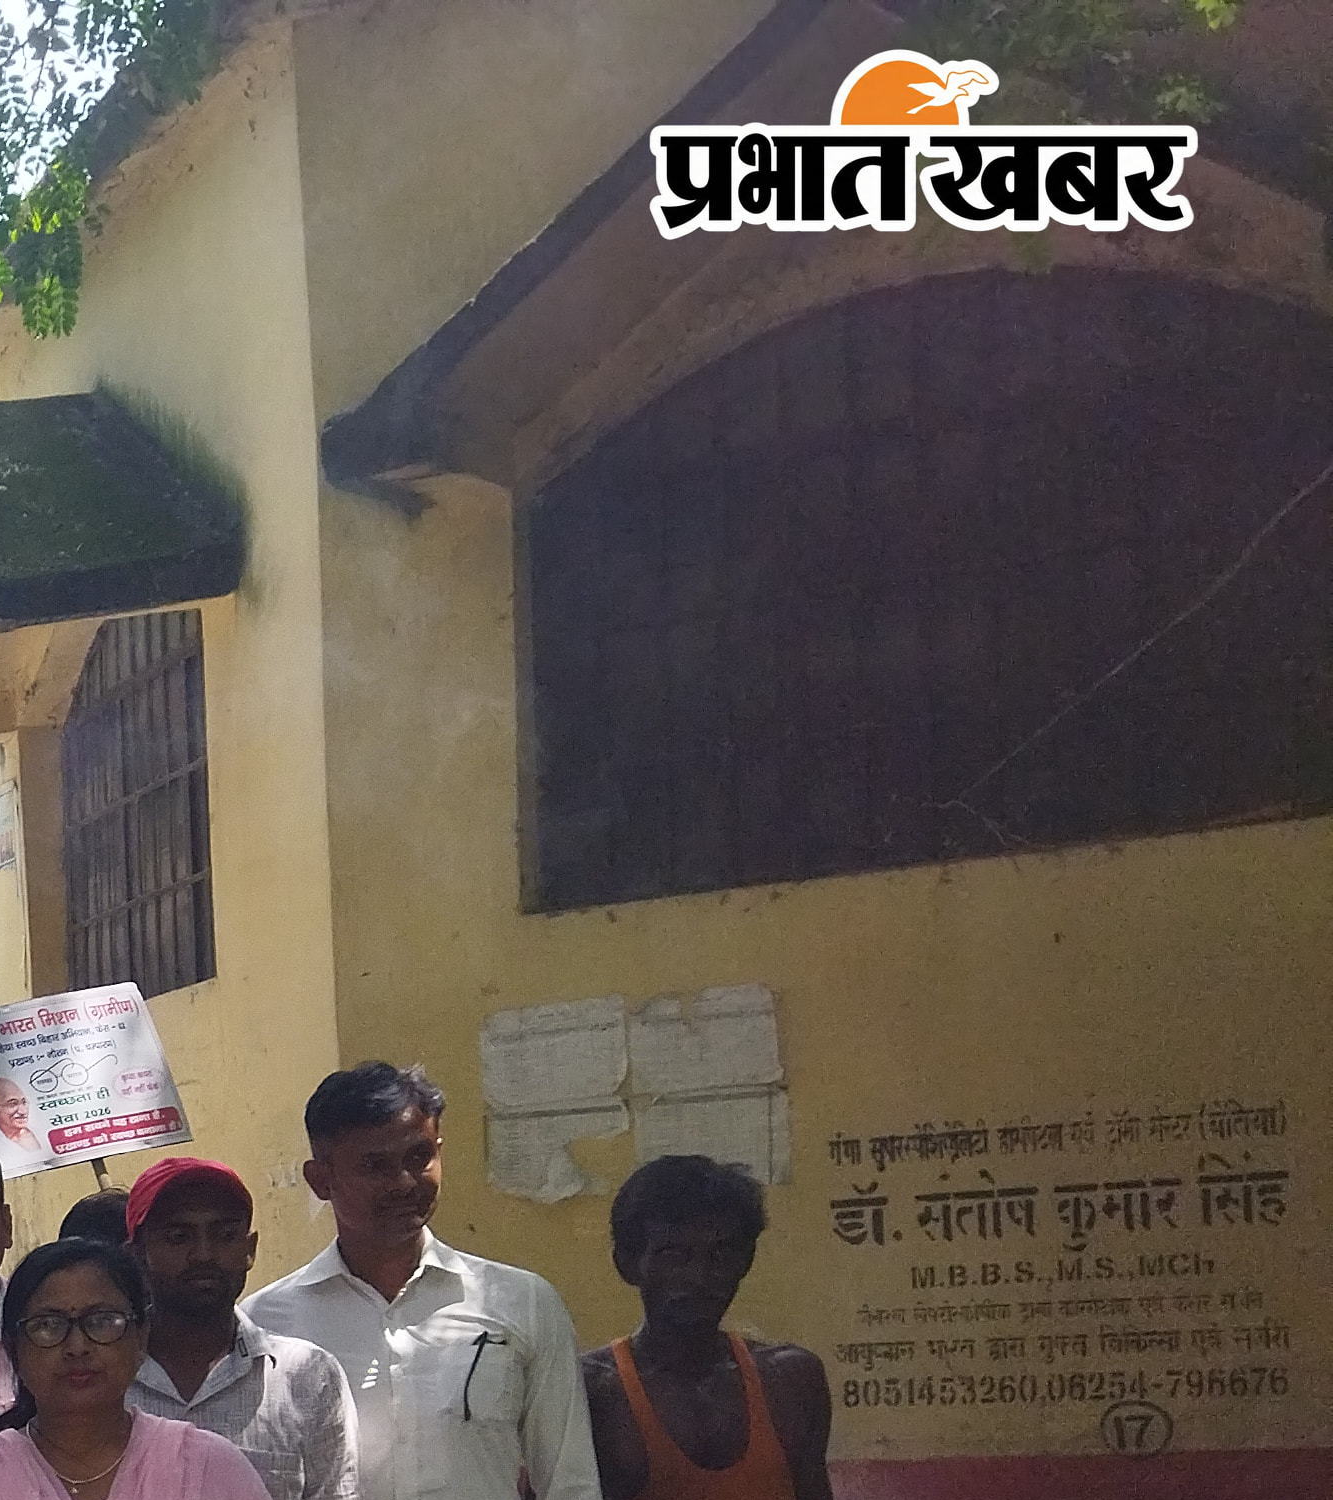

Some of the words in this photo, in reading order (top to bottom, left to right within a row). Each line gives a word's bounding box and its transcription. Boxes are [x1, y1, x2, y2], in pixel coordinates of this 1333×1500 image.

[0, 1018, 36, 1036] भारत
[38, 1007, 80, 1028] मिशन
[84, 994, 139, 1021] (ग्रामीण)
[38, 1092, 91, 1111] स्वच्छता
[96, 1087, 110, 1102] ही
[50, 1111, 79, 1127] सेवा
[85, 1107, 111, 1120] 2026
[831, 1180, 902, 1246] डॉ.
[915, 1171, 1039, 1241] संतोष
[1053, 1177, 1182, 1252] कुमार
[1197, 1153, 1289, 1228] सिंह
[1110, 1416, 1153, 1450] 17
